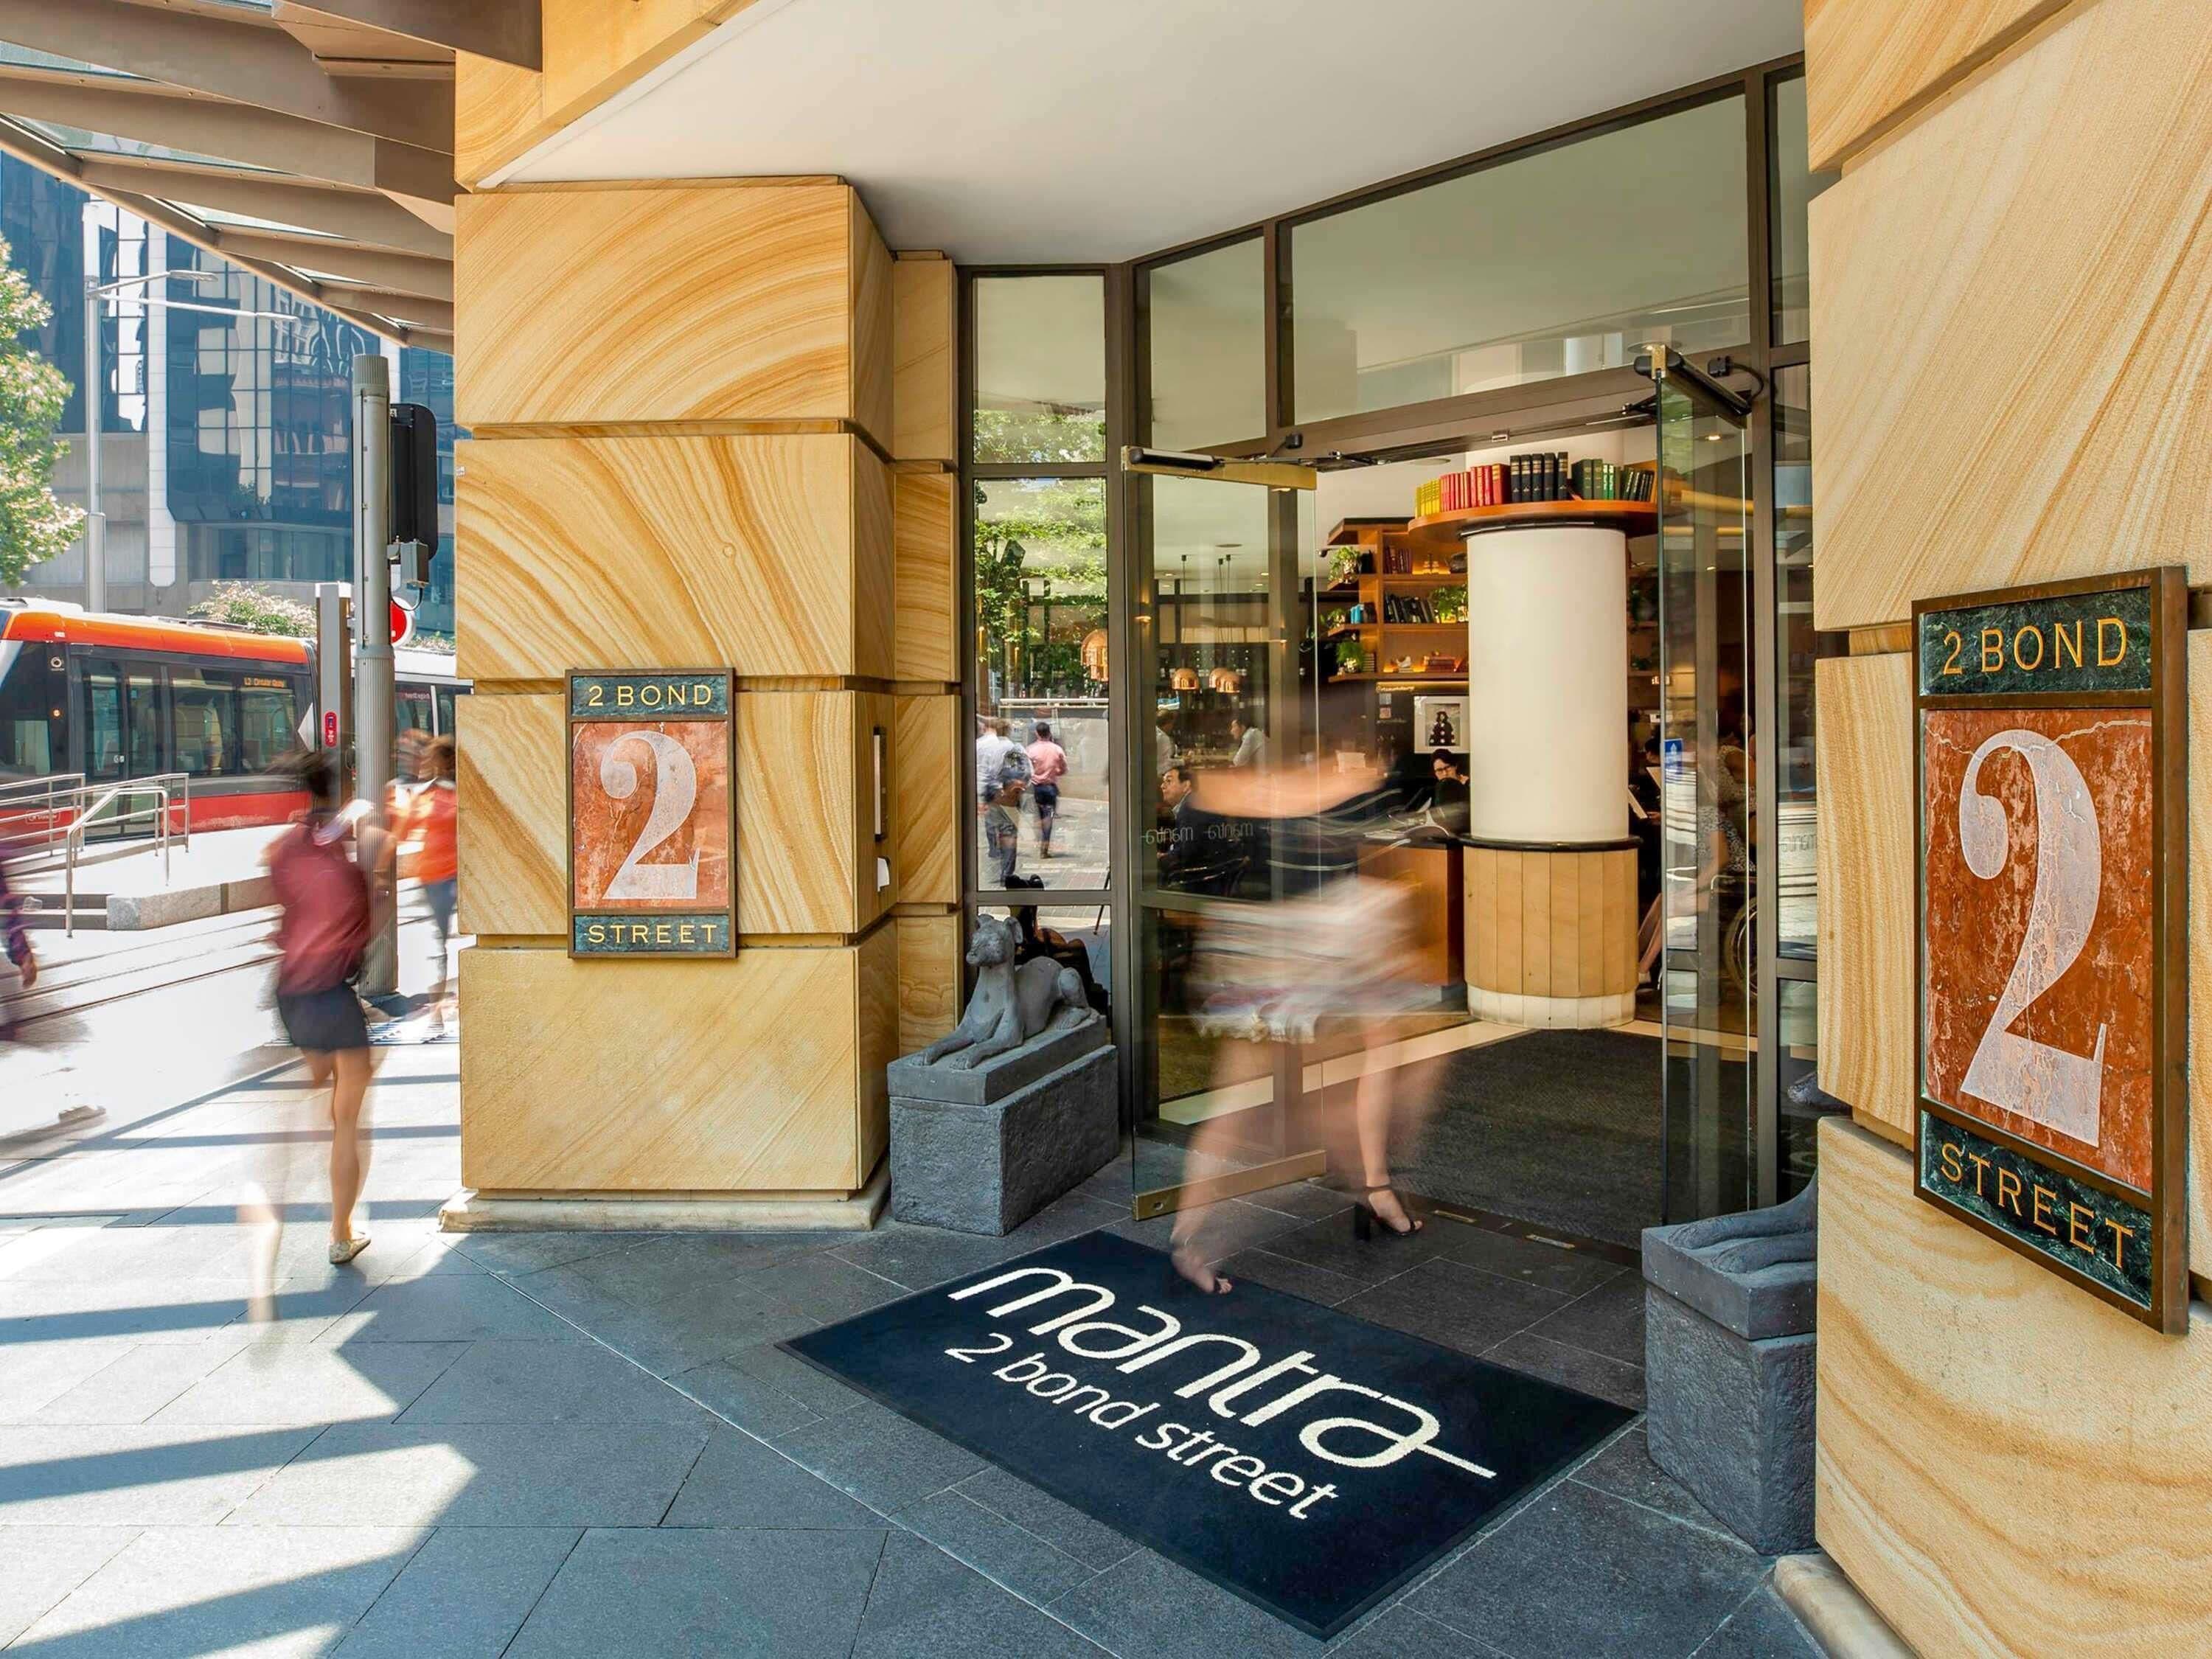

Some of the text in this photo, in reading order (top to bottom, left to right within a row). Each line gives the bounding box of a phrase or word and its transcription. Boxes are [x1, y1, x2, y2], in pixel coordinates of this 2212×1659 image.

[588, 685, 712, 706] 2 BOND
[1943, 617, 2127, 675] 2 BOND
[600, 730, 700, 900] 2
[588, 924, 717, 944] STREET
[1959, 729, 2107, 1148] 2
[1941, 1143, 2134, 1268] STREET
[945, 1333, 1340, 1520] 2 bond street
[947, 1267, 1498, 1478] mantra
